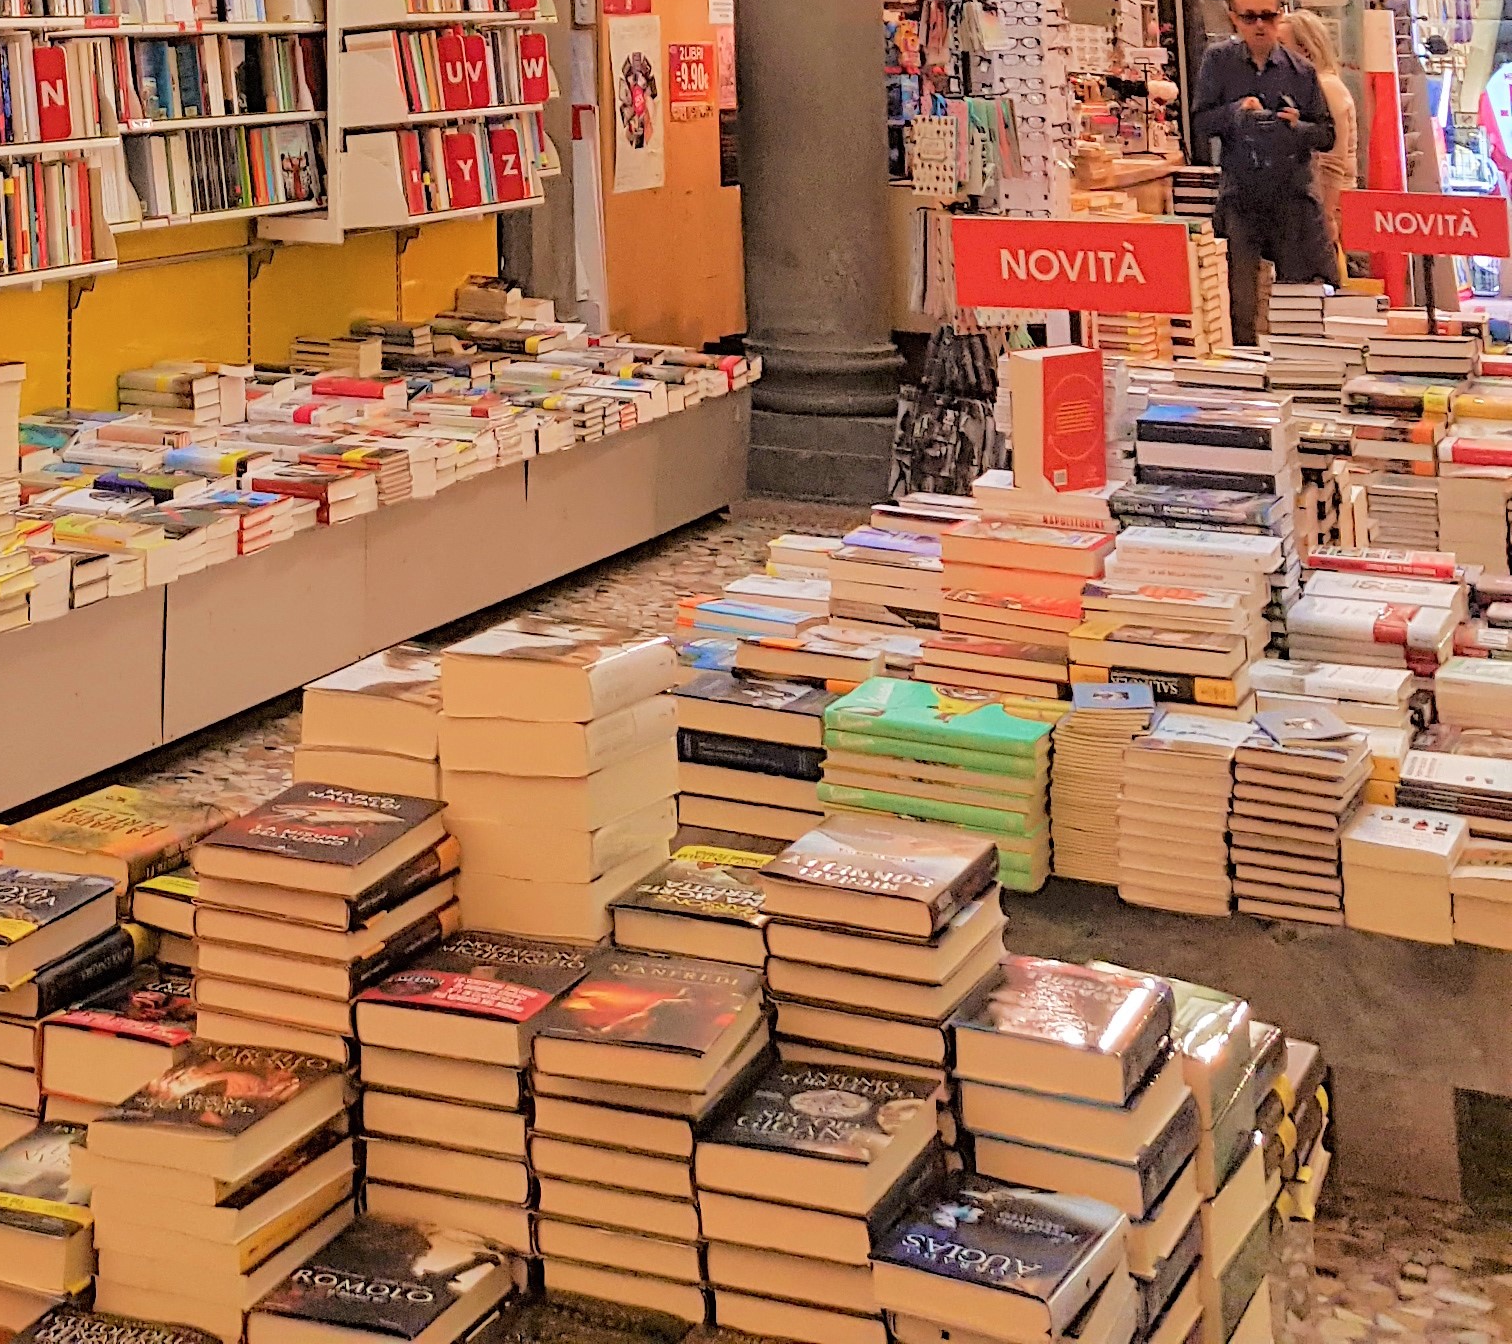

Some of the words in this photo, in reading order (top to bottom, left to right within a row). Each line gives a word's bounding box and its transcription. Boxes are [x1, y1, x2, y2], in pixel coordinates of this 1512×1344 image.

[446, 61, 463, 83] U
[467, 60, 483, 82] V
[523, 57, 545, 79] W
[40, 77, 65, 109] N
[456, 159, 474, 181] Y
[502, 154, 519, 175] Z
[1374, 207, 1478, 239] NOVITÀ
[1000, 242, 1146, 285] NOVITÀ
[291, 1269, 434, 1303] ROMOLO
